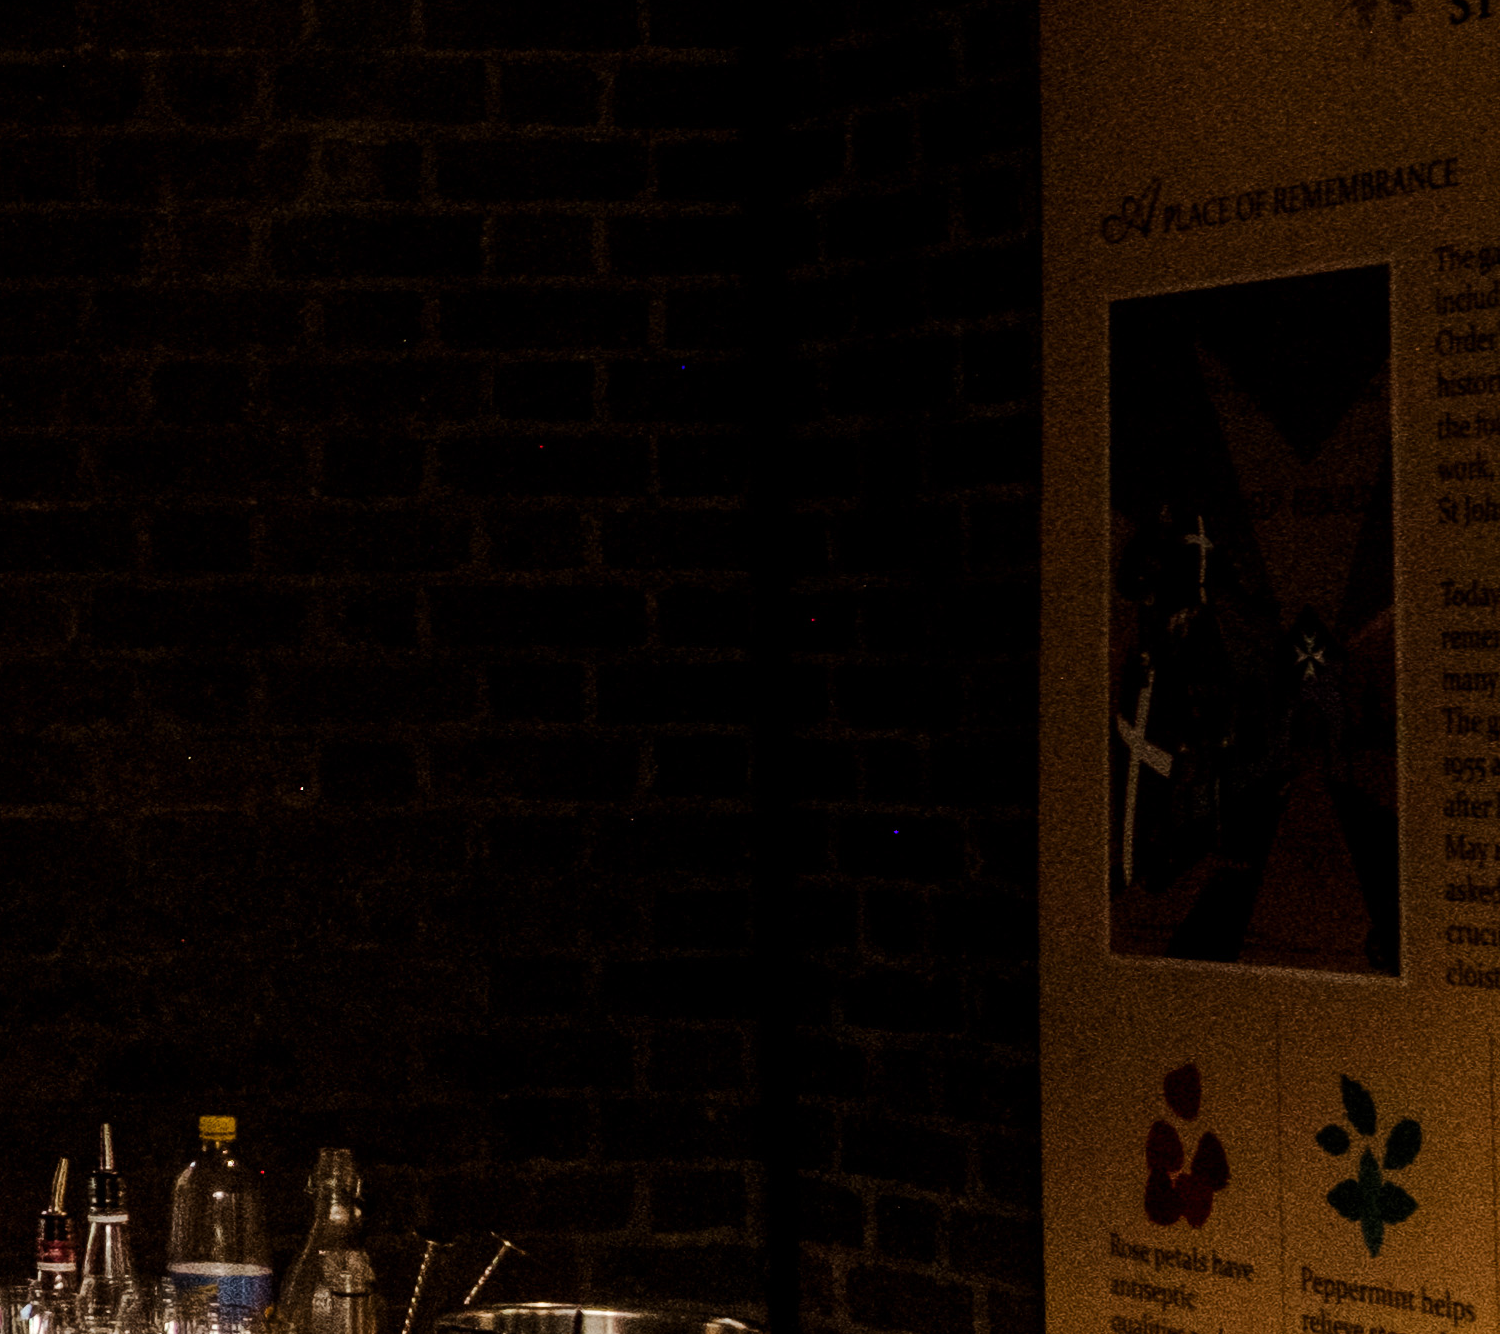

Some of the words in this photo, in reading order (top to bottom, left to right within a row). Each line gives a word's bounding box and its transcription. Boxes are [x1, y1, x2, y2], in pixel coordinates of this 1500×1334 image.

[1100, 176, 1162, 244] A
[1163, 196, 1229, 233] PLACE
[1236, 188, 1271, 222] OF
[1273, 157, 1460, 216] REMEMBRANCE
[1434, 244, 1475, 273] The
[1435, 323, 1497, 356] Order
[1437, 412, 1470, 439] the
[1437, 496, 1459, 525] St
[1442, 671, 1499, 699] many
[1441, 705, 1483, 736] The
[1444, 756, 1487, 784] 1955
[1444, 789, 1492, 819] after
[1444, 834, 1489, 869] May
[1109, 1231, 1151, 1265] Rose
[1153, 1246, 1209, 1273] petals
[1211, 1248, 1255, 1283] have
[1109, 1277, 1198, 1312] antiseptic
[1300, 1264, 1416, 1312] Peppermint
[1419, 1285, 1478, 1328] helps
